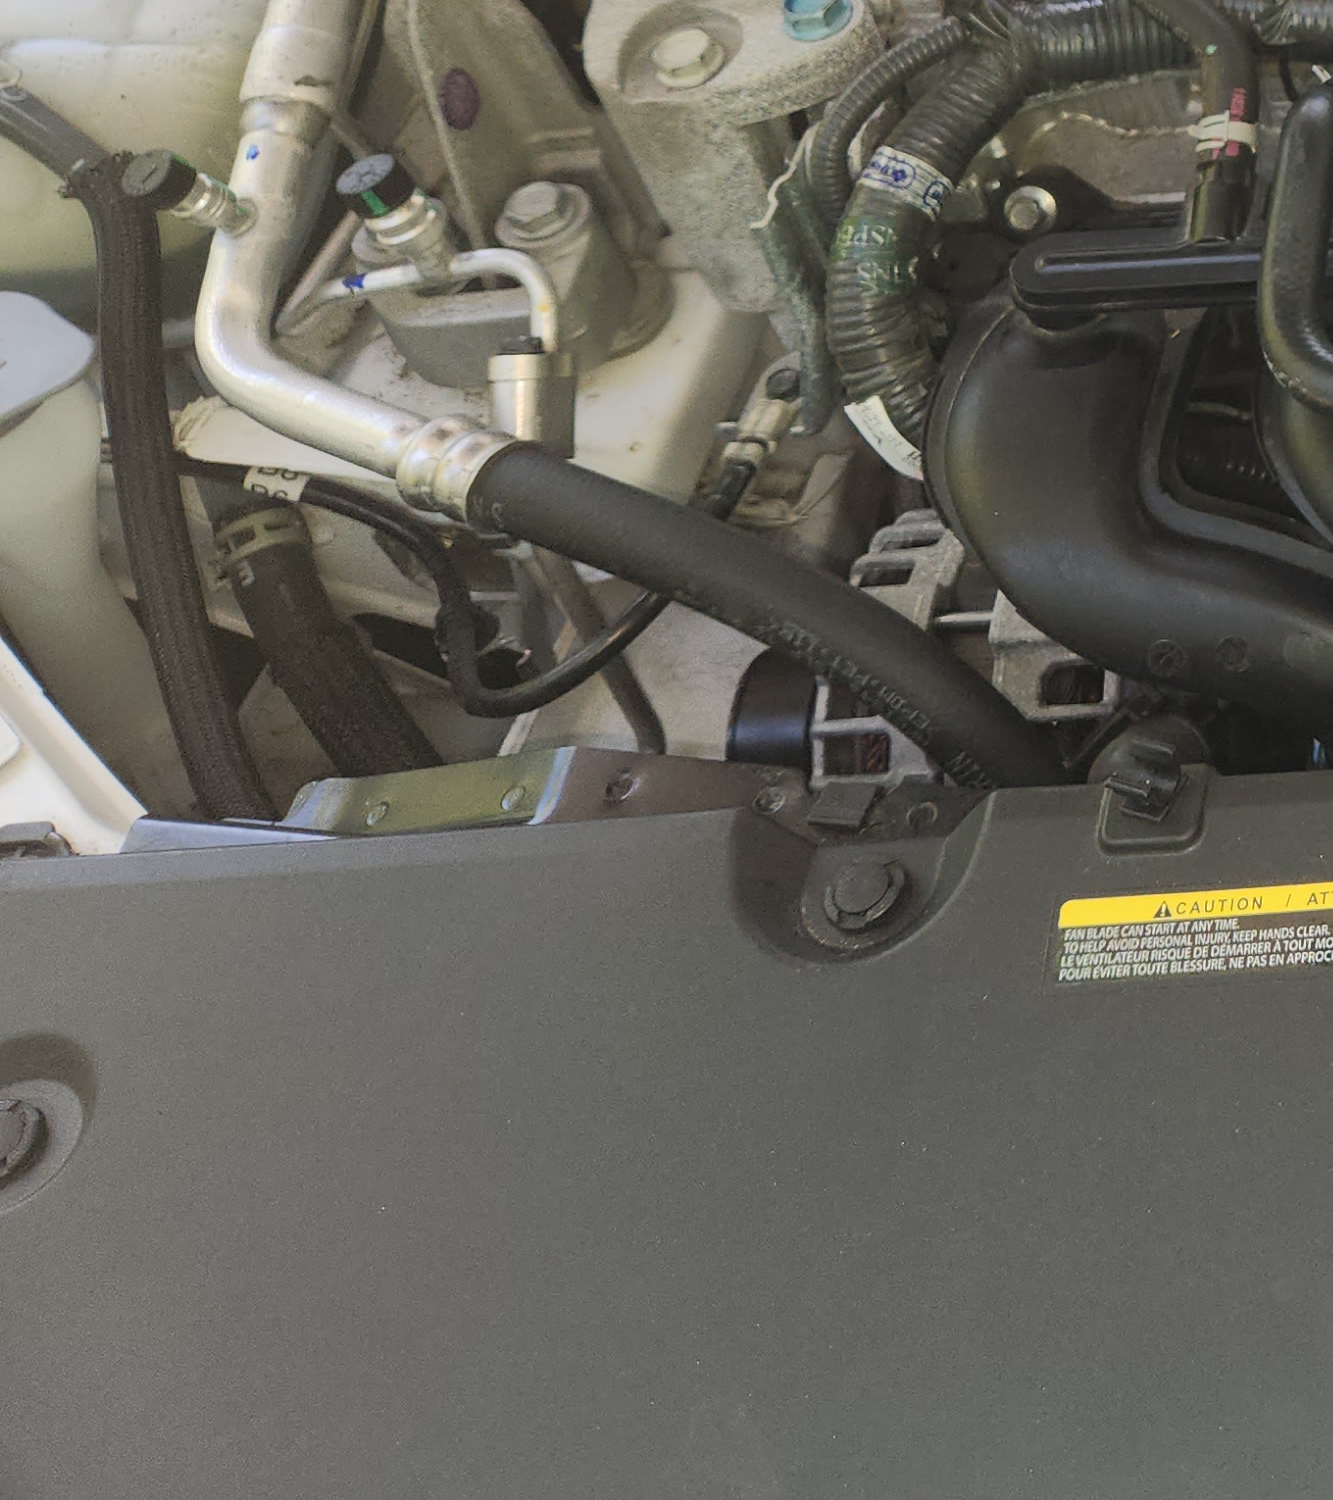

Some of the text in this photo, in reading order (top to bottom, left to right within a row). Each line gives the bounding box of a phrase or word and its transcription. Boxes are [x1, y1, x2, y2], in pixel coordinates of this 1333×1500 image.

[1175, 896, 1263, 915] CAUTION
[1064, 918, 1240, 940] FAN BLADE CAN START AT ANY TIME.
[1064, 942, 1079, 954] TO
[1079, 940, 1106, 953] HELP
[1107, 938, 1139, 951] AVOID
[1140, 934, 1193, 949] PERSONAL
[1233, 930, 1257, 943] KEEP
[1259, 927, 1295, 940] HANDS
[1297, 924, 1330, 938] CLEAR.
[1061, 956, 1075, 967] LE
[1076, 950, 1149, 966] VENTILATEUR
[1151, 947, 1191, 961] RISQUE
[1193, 946, 1208, 958] DE
[1283, 938, 1314, 951] TOUT
[1059, 968, 1091, 981] POUR
[1093, 964, 1131, 979] ÉVITER
[1132, 962, 1168, 976] TOUTE
[1229, 957, 1244, 969] NE
[1245, 955, 1266, 968] PAS
[1269, 954, 1284, 966] EN
